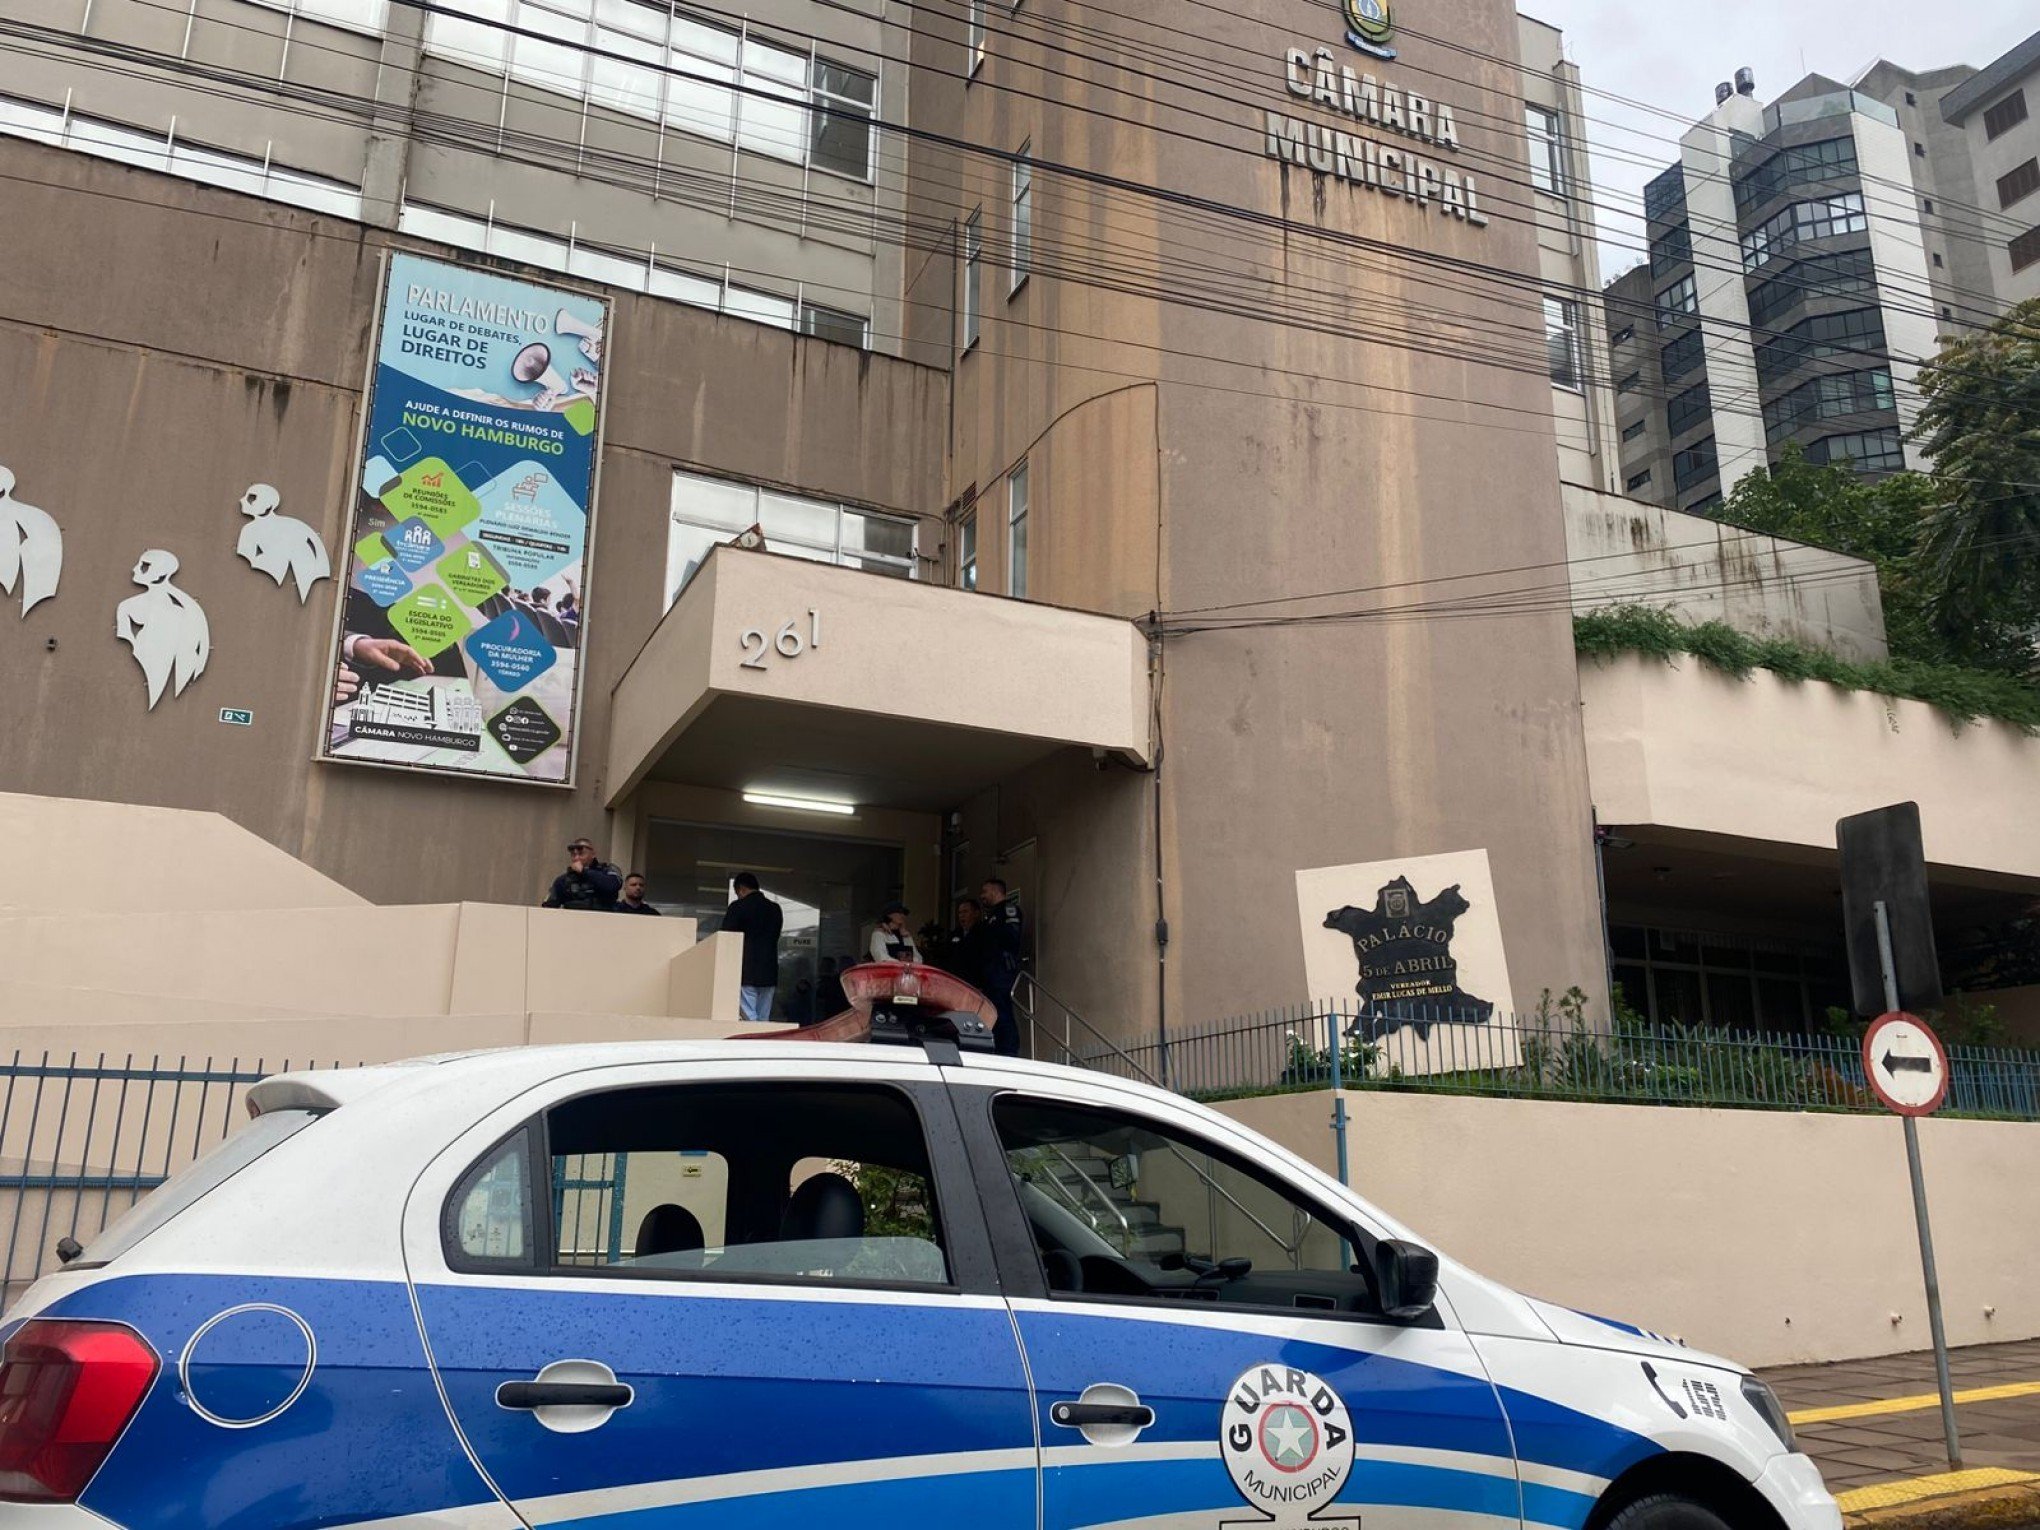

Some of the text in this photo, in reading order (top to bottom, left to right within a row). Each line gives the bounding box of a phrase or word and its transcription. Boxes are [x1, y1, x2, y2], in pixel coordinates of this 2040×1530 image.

[1285, 47, 1460, 152] CÂMARA
[1265, 111, 1488, 228] MUNICIPAL
[407, 282, 548, 334] PARLAMENTO
[403, 324, 489, 353] LUGAR DE
[404, 310, 522, 346] LUGAR DE DEBATES,
[401, 339, 487, 369] DIREITOS
[402, 411, 564, 455] NOVO HAMBURGO
[405, 400, 564, 440] AJUDE A DEFINIR OS RUMOS DE
[414, 495, 456, 507] COMISSÕES
[405, 617, 454, 630] LEGISLATIVO
[409, 610, 437, 620] ESCOLA
[740, 607, 820, 671] 261
[355, 726, 476, 747] CÂMARA NOVO HAMBURGO
[1357, 920, 1447, 952] PALÁCIO
[1363, 956, 1452, 978] 5 DE ABRIL
[1391, 980, 1431, 989] VEREADOR
[1229, 1368, 1346, 1452] GUARDA
[1244, 1467, 1341, 1502] MUNICIPAL
